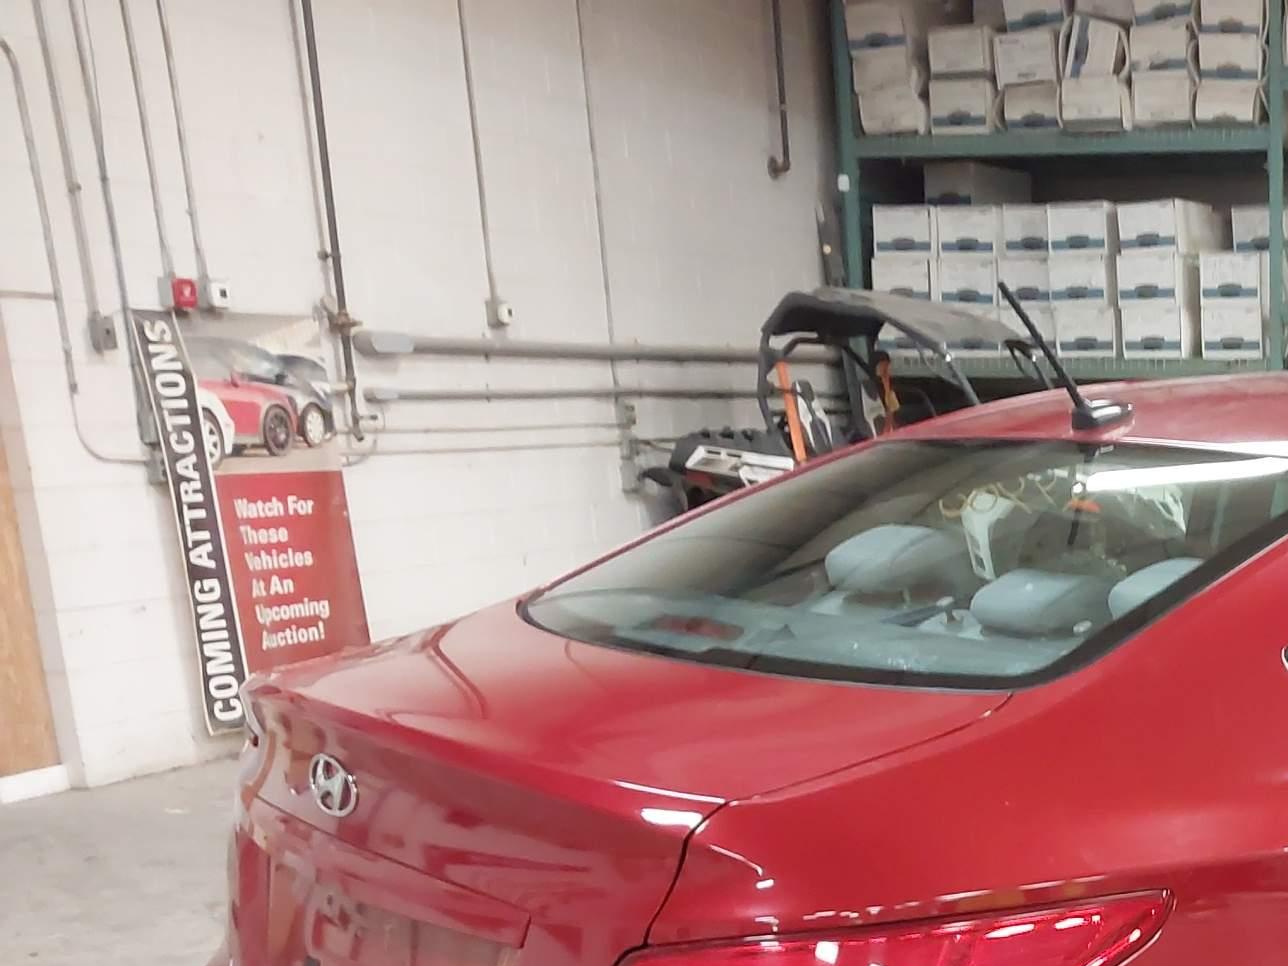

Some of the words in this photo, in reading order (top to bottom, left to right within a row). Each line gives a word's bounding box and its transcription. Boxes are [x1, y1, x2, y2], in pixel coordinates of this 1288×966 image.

[144, 319, 217, 570] ATTRACTIONS
[234, 497, 285, 519] Watch
[287, 495, 314, 516] For
[239, 525, 289, 545] These
[245, 548, 314, 571] Vehicles
[252, 578, 267, 599] At
[269, 575, 295, 596] An
[255, 598, 331, 627] Upcoming
[262, 621, 326, 651] Auction!
[194, 578, 243, 722] COMING
